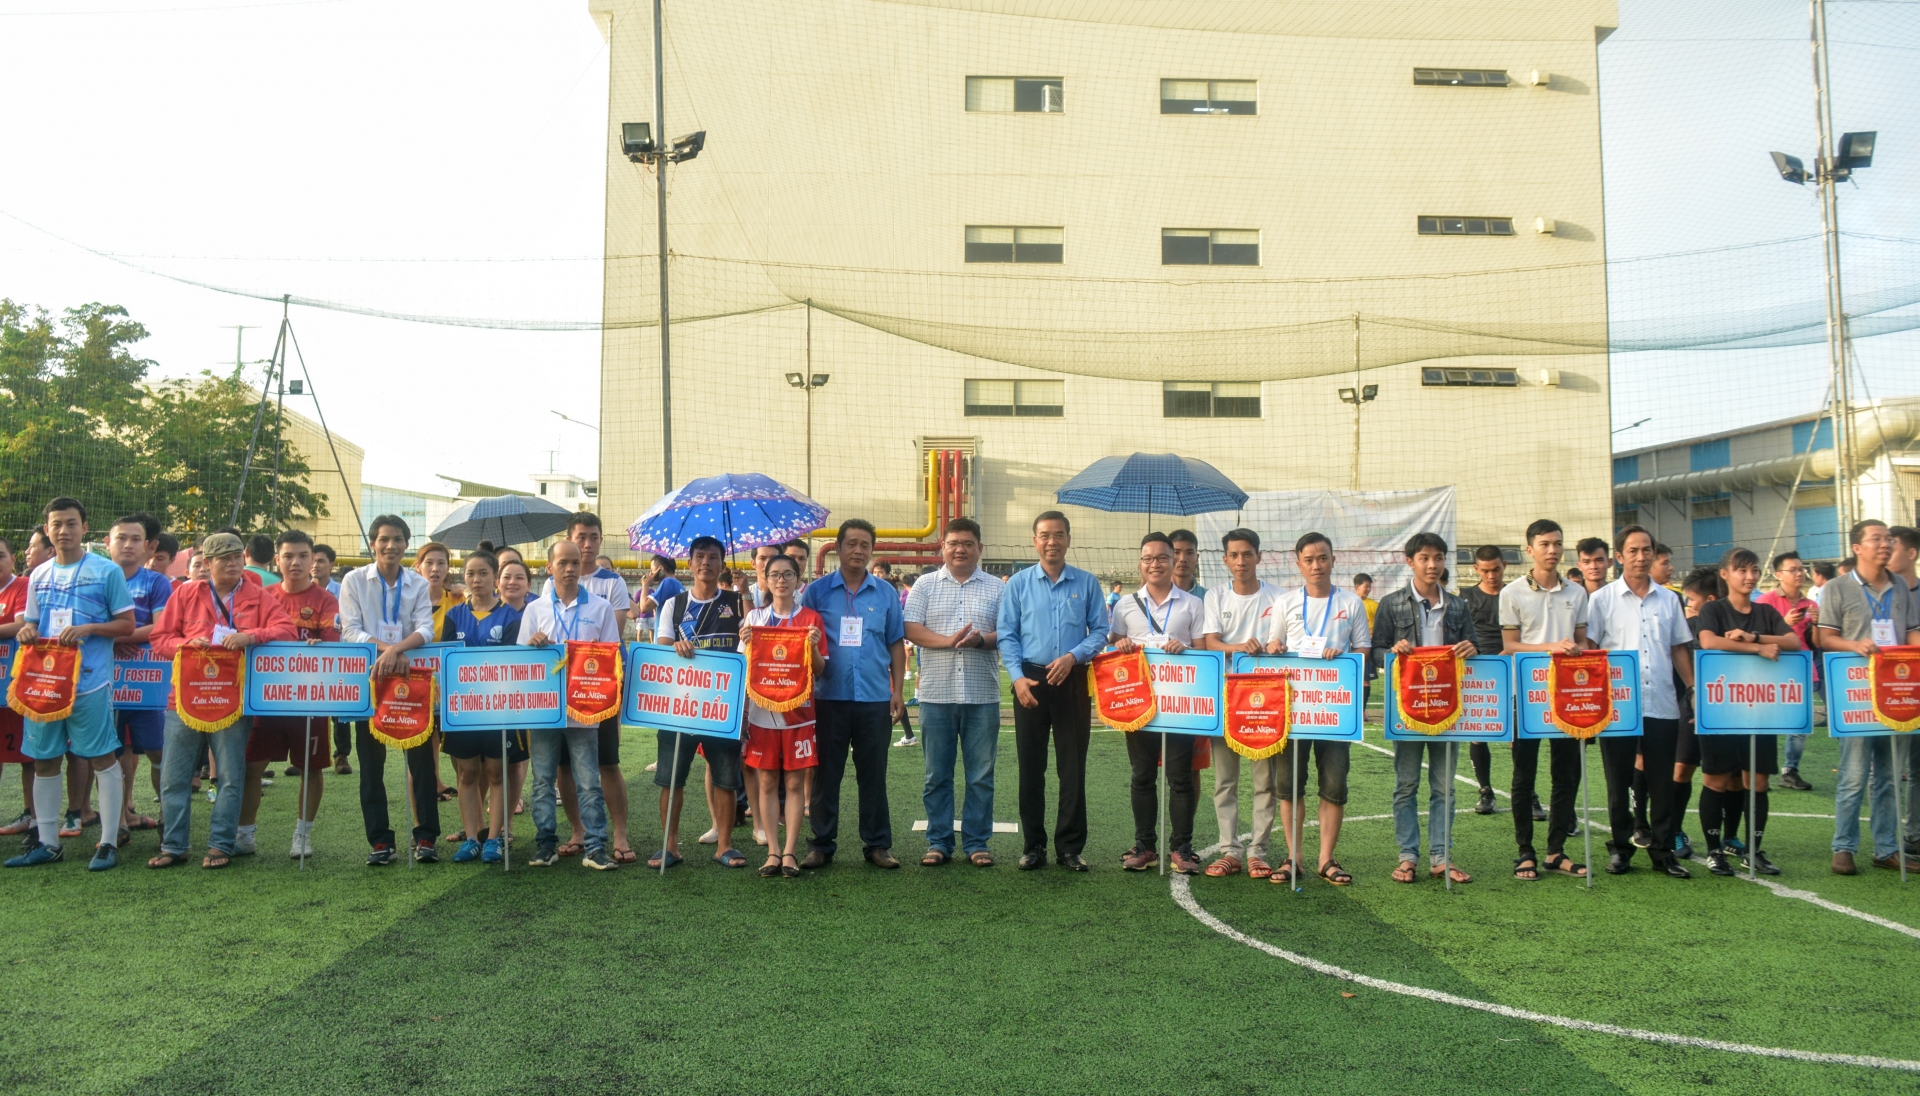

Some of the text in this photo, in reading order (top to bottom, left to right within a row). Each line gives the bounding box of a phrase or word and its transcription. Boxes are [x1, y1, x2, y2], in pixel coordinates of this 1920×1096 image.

[255, 653, 366, 674] CĐCS CÔNG TY TNHH
[458, 662, 546, 683] CĐCS CÔNG TY TNHH MTV
[1159, 661, 1183, 683] CÔNG
[1185, 665, 1196, 684] TY
[1847, 666, 1870, 681] CĐC
[125, 669, 162, 682] FOSTER
[640, 663, 731, 691] CĐCS CÔNG TY
[1303, 668, 1313, 682] TY
[1316, 668, 1338, 682] TNHH
[1532, 669, 1549, 681] CĐC
[263, 678, 359, 701] KANE-M ĐÀ NẴNG
[1301, 689, 1323, 706] THỰC
[1325, 686, 1351, 704] PHẨM
[1528, 690, 1547, 703] BAO
[1706, 675, 1802, 708] TỔ TRỌNG TÀI
[449, 691, 459, 715] HỆ
[460, 688, 484, 712] THỐNG
[485, 694, 491, 711] &
[492, 690, 507, 711] CÁP
[508, 690, 526, 713] ĐIỆN
[637, 692, 729, 721] TNHH BẮC ĐẨU
[1161, 695, 1191, 715] DAIJIN
[1193, 696, 1214, 716] VINA
[1463, 694, 1498, 706] DỊCH VỤ
[1300, 709, 1312, 725] ĐÀ
[1313, 707, 1339, 726] NẴNG
[1485, 722, 1503, 733] KCN
[5, 733, 15, 751] 2
[794, 739, 812, 759] 20
